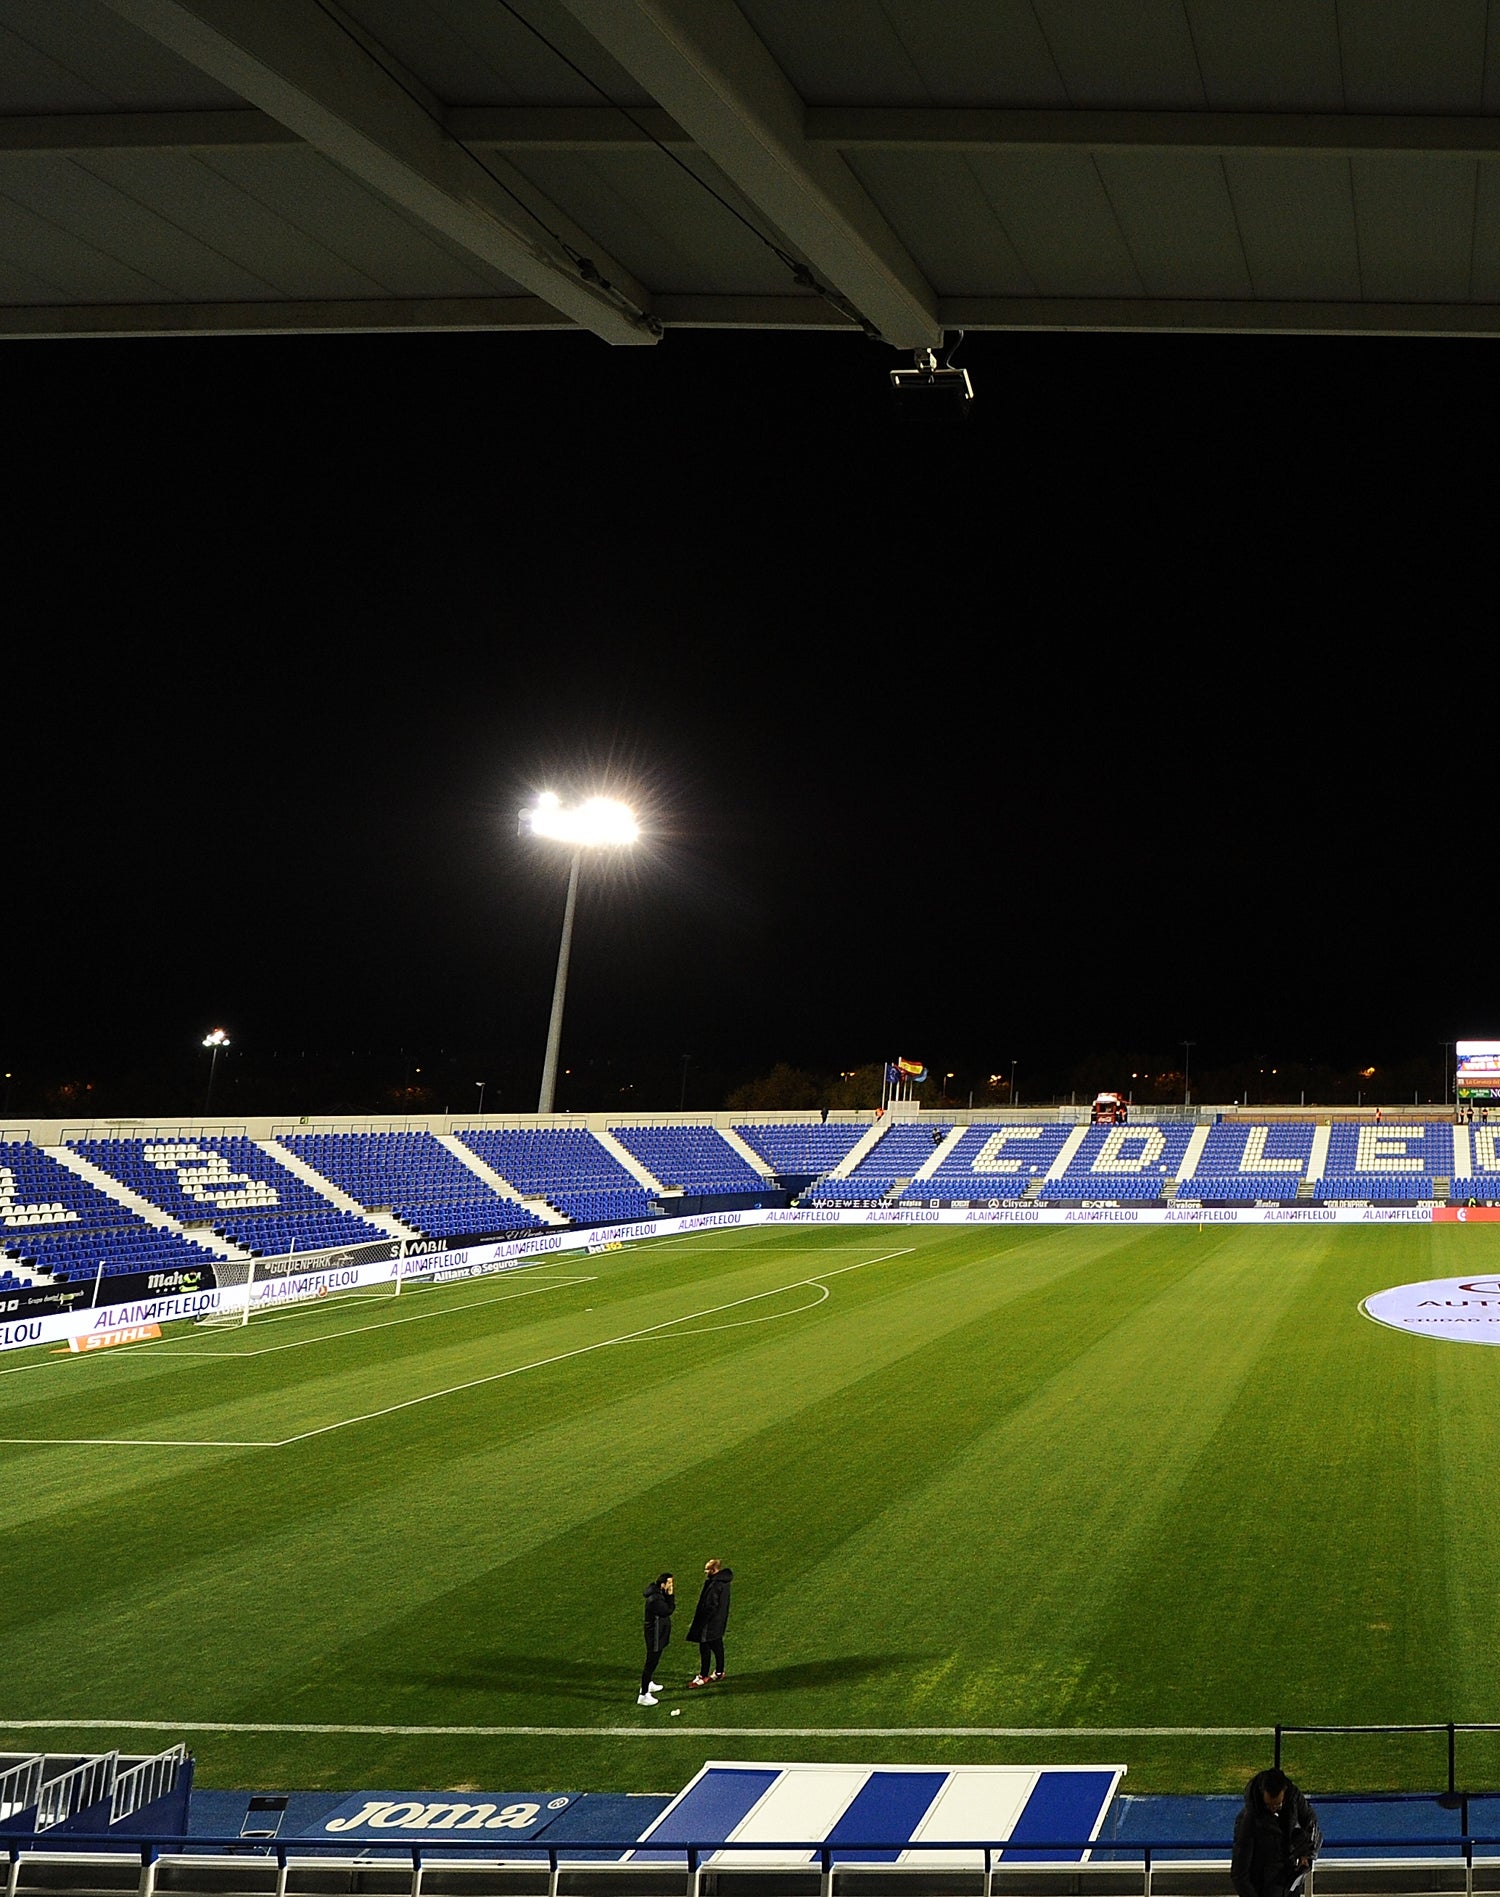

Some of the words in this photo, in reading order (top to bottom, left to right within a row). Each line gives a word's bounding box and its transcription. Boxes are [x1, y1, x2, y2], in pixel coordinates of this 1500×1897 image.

[1033, 1199, 1048, 1208] Sur
[434, 1267, 470, 1283] Allianz
[482, 1258, 519, 1273] Seguros
[86, 1325, 152, 1349] STIHL
[325, 1801, 541, 1832] Joma
